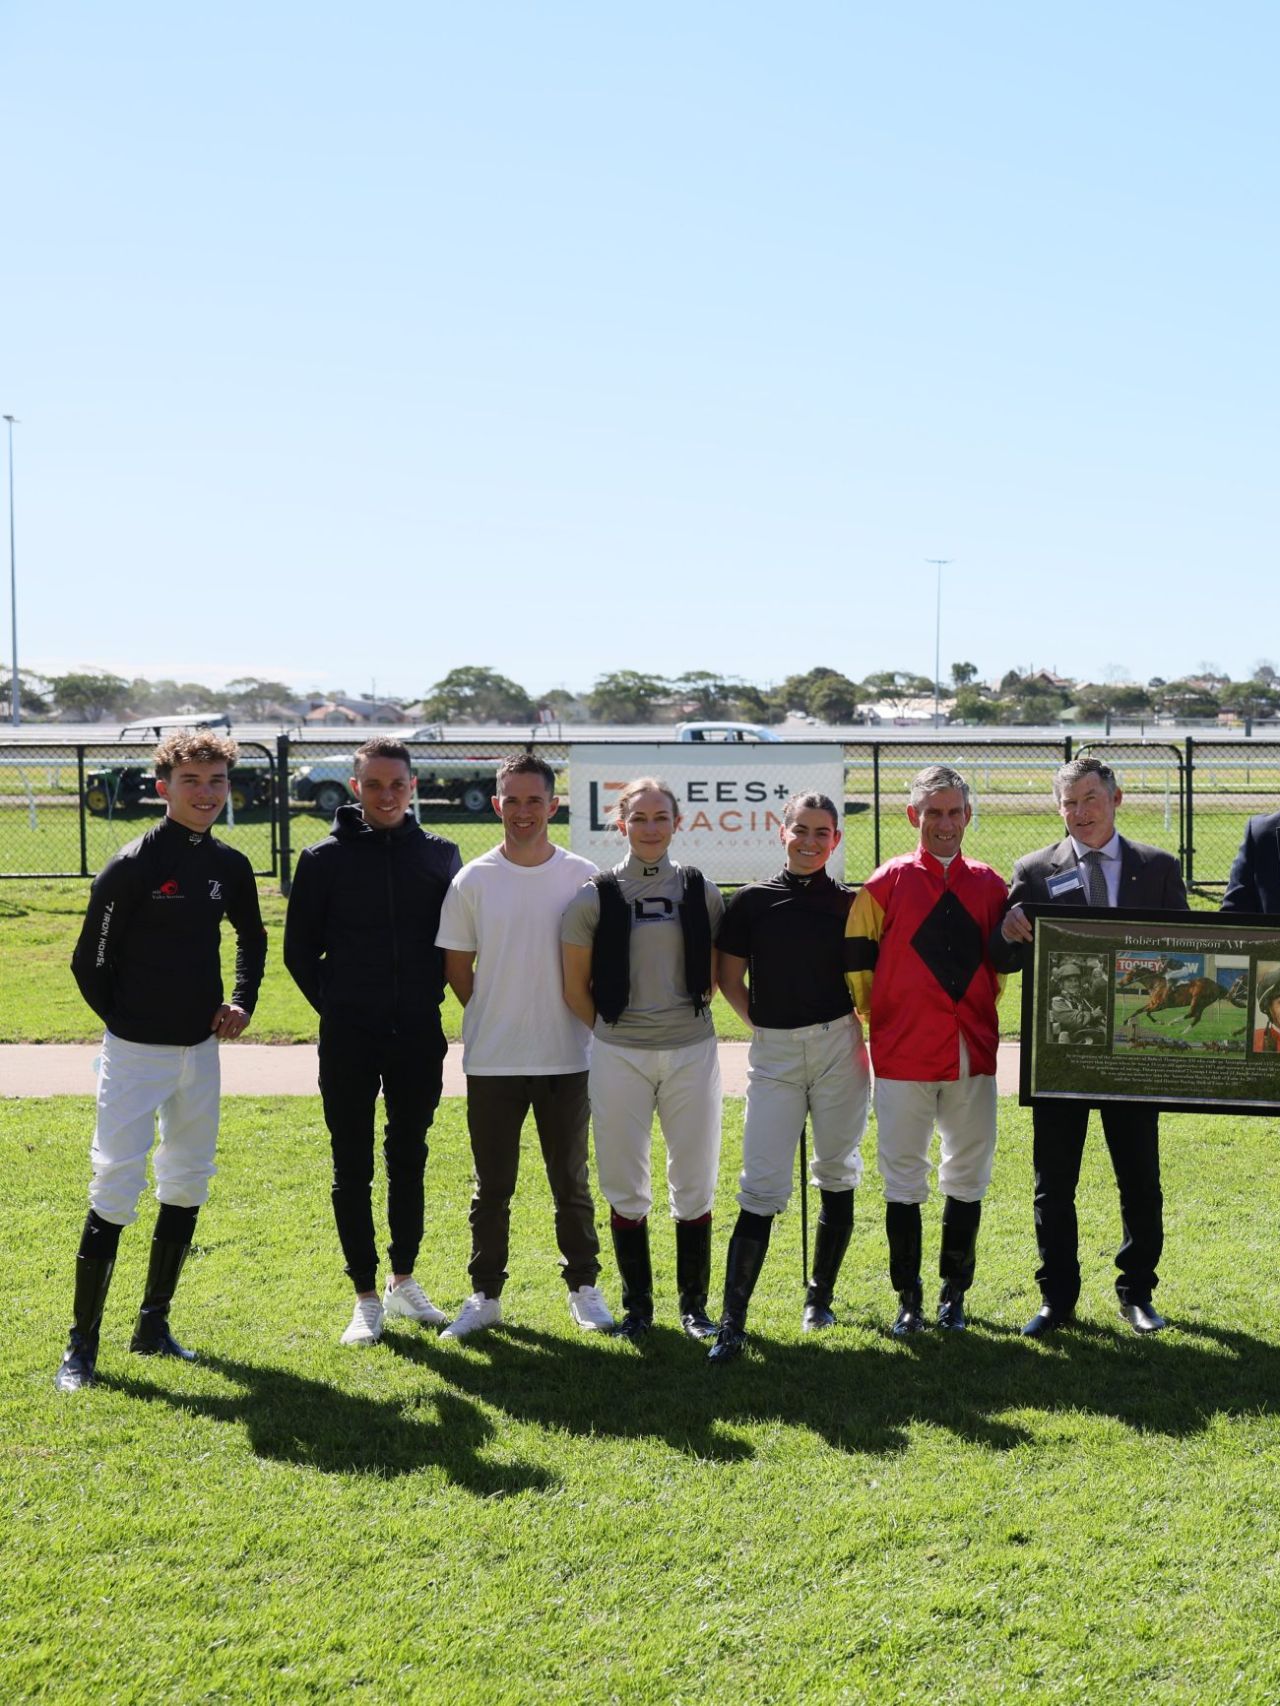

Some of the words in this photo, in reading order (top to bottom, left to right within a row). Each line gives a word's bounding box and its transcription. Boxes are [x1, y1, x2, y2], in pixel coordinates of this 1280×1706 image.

[101, 912, 111, 936] IRON
[1125, 935, 1160, 946] Robert
[1163, 937, 1221, 949] Thompson
